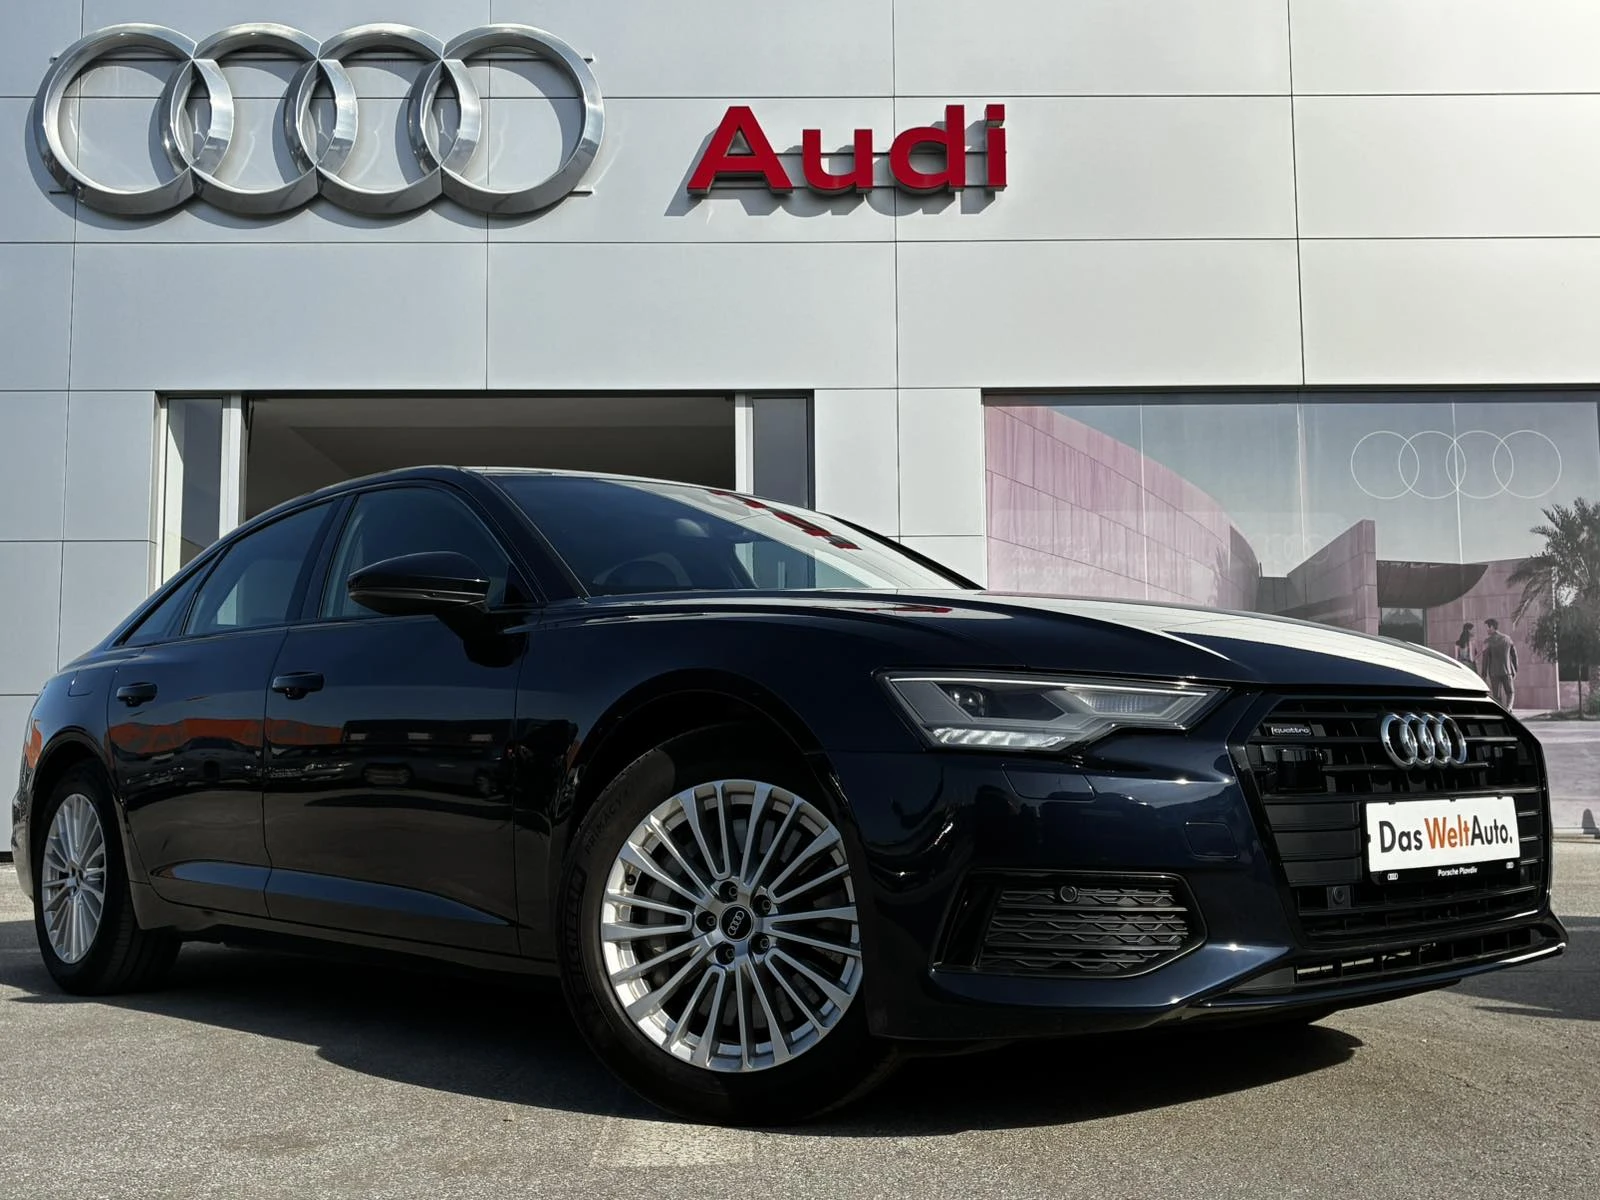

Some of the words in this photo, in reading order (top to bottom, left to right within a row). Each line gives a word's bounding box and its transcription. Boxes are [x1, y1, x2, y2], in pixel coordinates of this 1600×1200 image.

[687, 104, 1007, 194] Audi
[1272, 727, 1310, 735] quattro
[584, 794, 622, 855] PRIMACY
[1379, 820, 1423, 853] Das
[1437, 868, 1458, 876] Porsche
